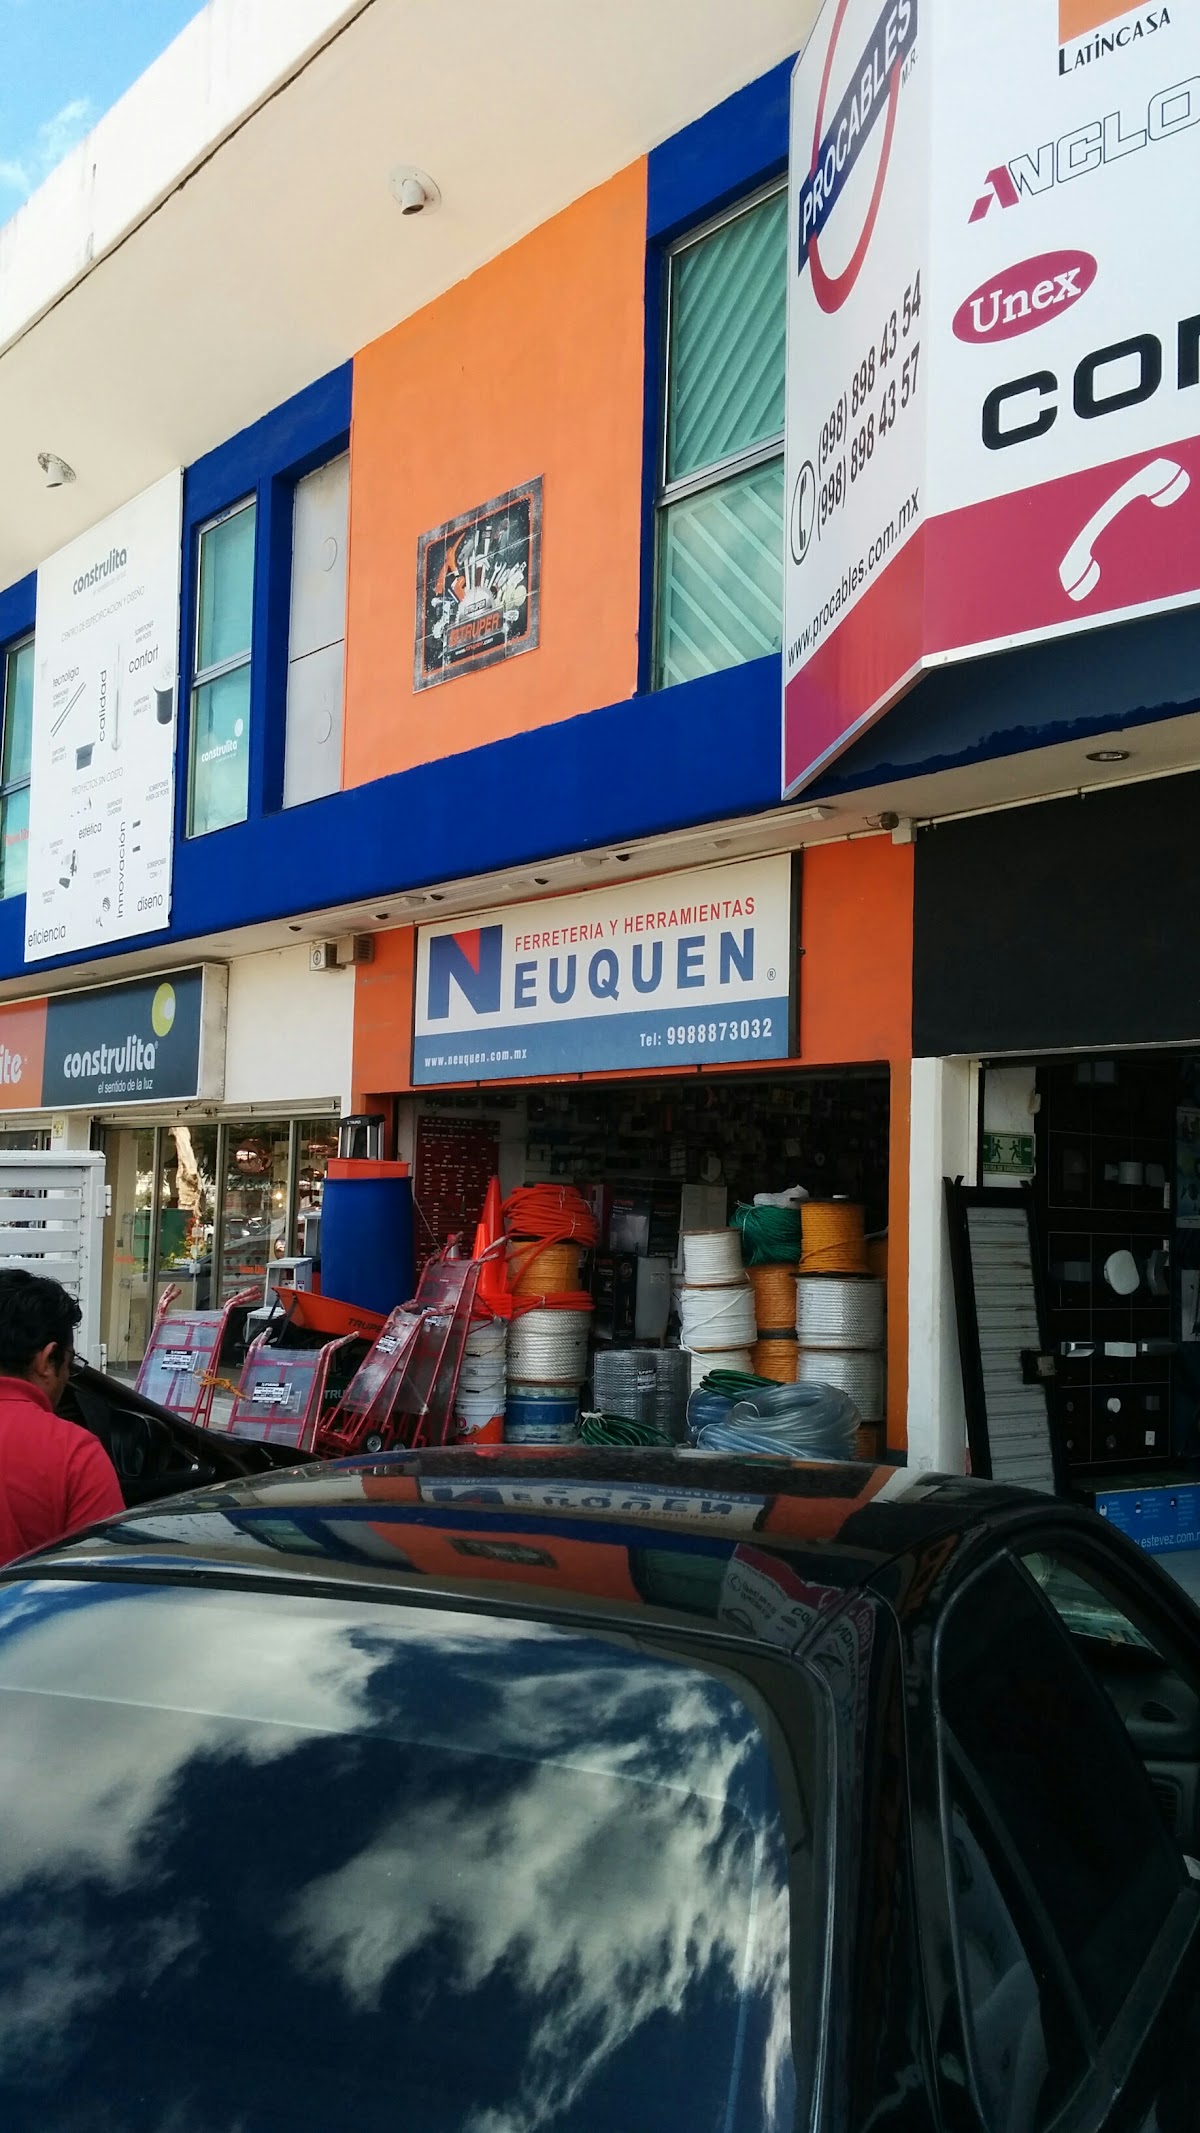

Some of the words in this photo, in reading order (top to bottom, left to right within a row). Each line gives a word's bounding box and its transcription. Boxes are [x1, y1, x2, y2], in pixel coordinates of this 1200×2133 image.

[802, 0, 911, 245] PROCABLES
[969, 266, 1082, 333] Unex
[818, 391, 848, 481] (998)
[851, 345, 876, 418] 898
[879, 309, 897, 370] 43
[902, 268, 921, 338] 54
[817, 454, 847, 541] (998)
[850, 412, 875, 483] 898
[878, 379, 896, 436] 43
[901, 340, 920, 409] 57
[72, 547, 127, 596] construlita
[787, 487, 920, 667] www.procables.com.mx
[459, 613, 500, 643] TRUPER
[128, 644, 159, 673] confort
[99, 669, 107, 742] calidad
[116, 821, 126, 919] innovación
[136, 892, 164, 913] diseño
[514, 921, 603, 952] FERRETERIA
[609, 919, 619, 937] Y
[624, 896, 756, 934] HERRAMIENTAS
[27, 923, 67, 947] eficiencia
[427, 923, 755, 1021] NEUQUEN
[63, 1034, 156, 1079] construlita
[424, 1048, 527, 1068] www.neuquen.com.mx
[640, 1032, 662, 1047] Tel:
[666, 1017, 773, 1046] 9988873032
